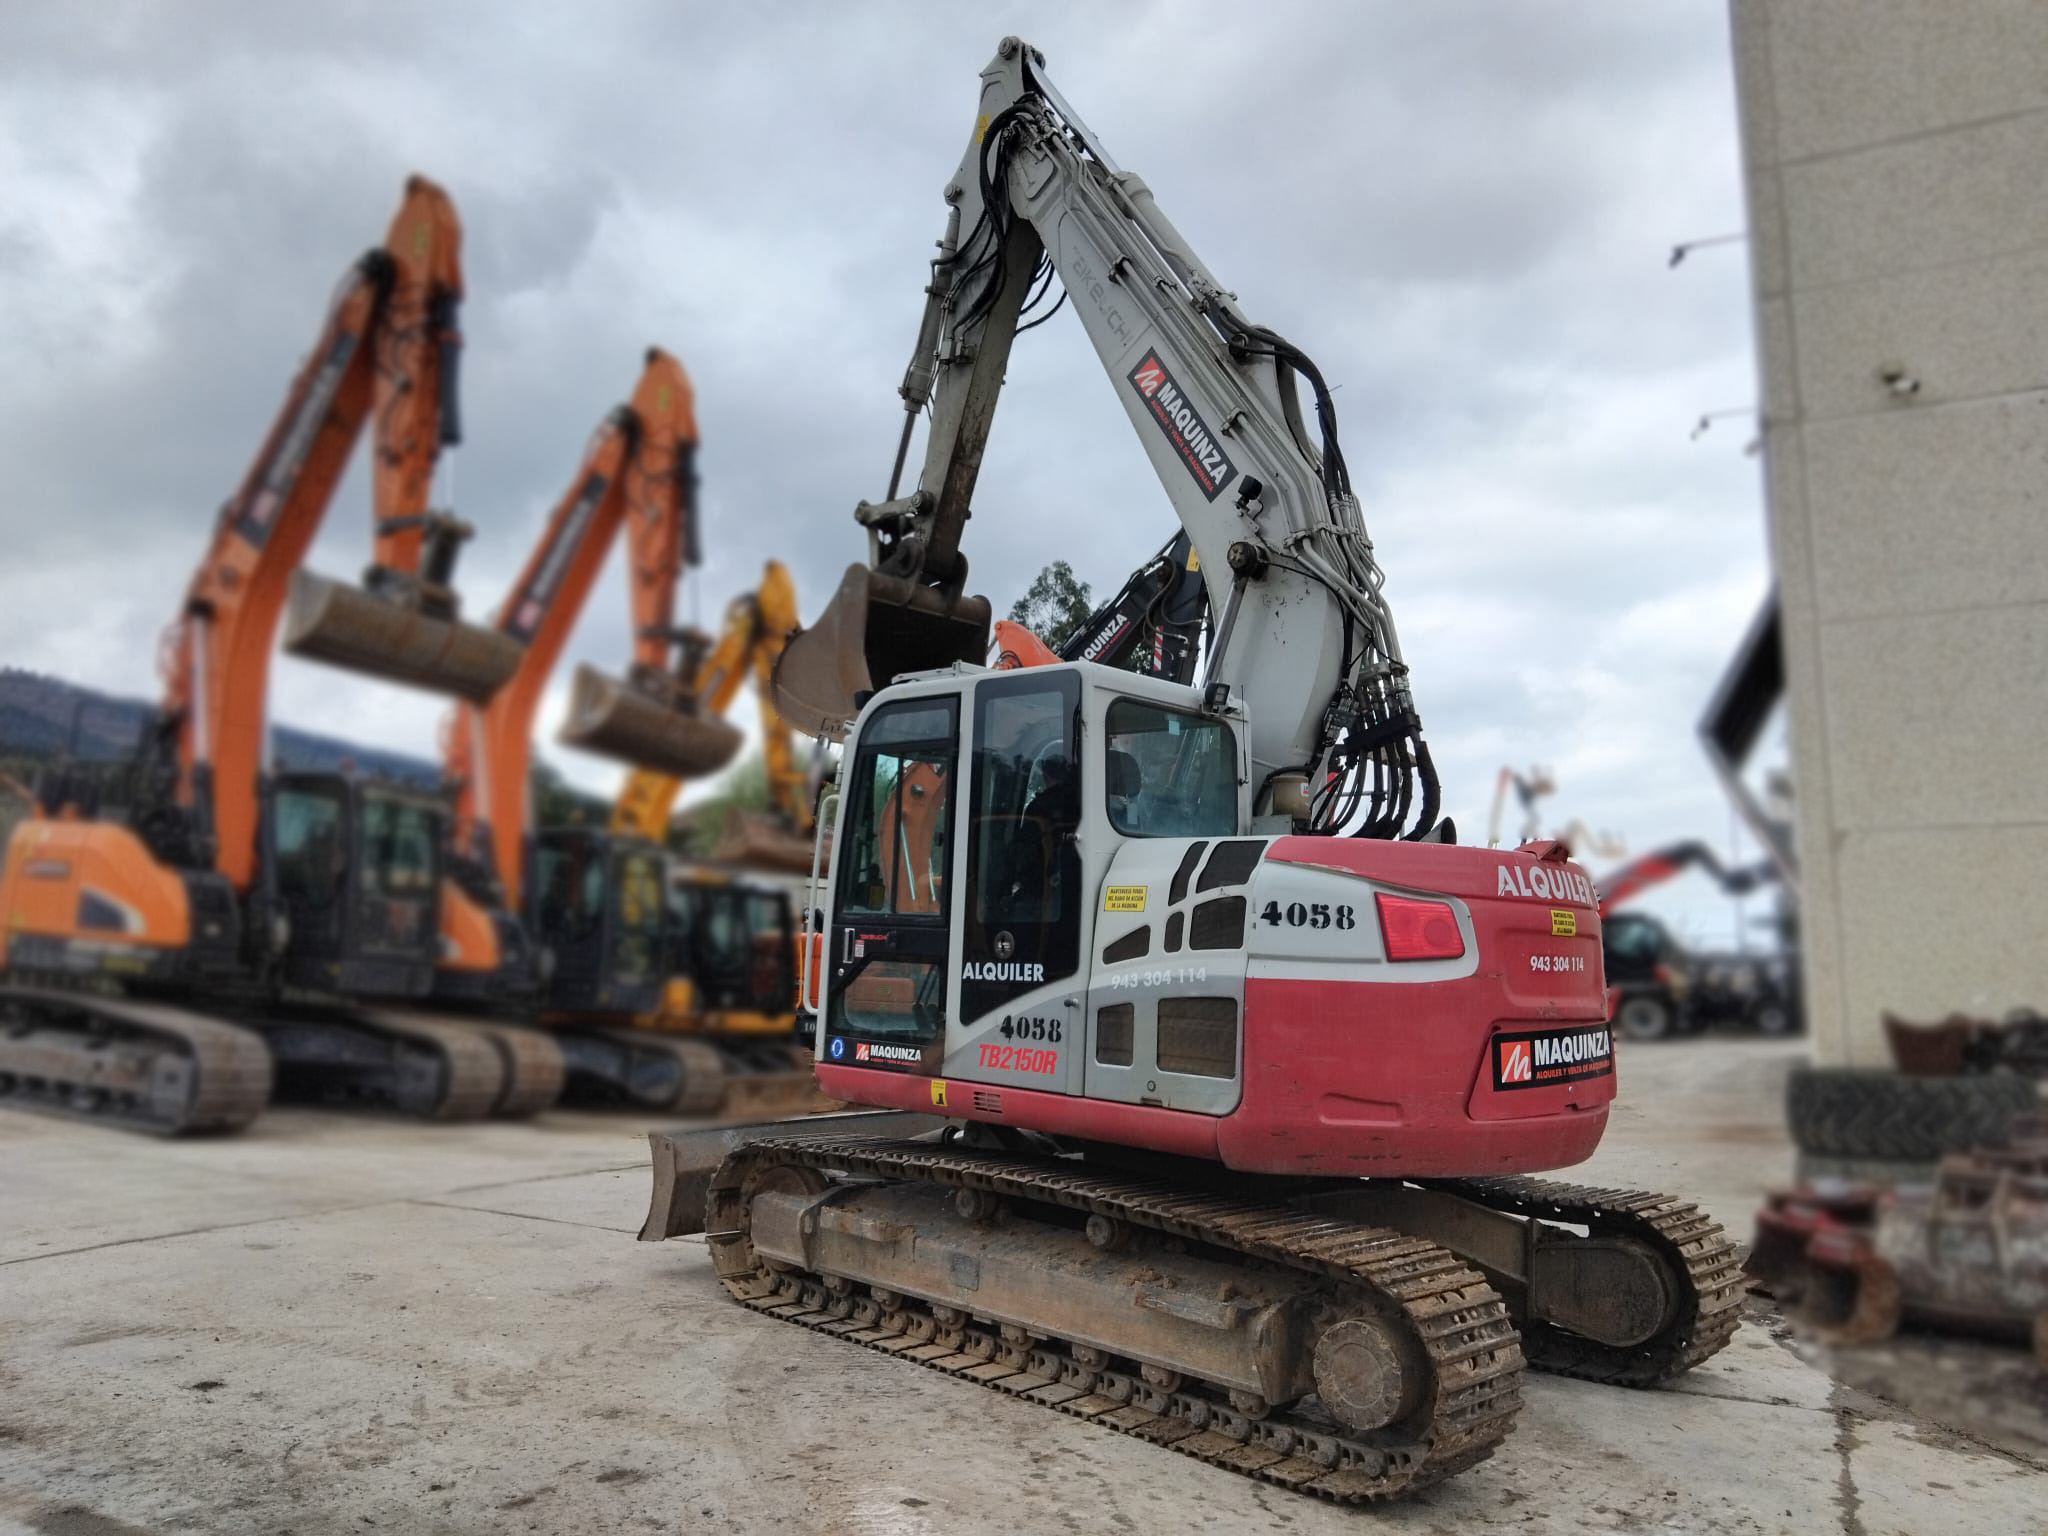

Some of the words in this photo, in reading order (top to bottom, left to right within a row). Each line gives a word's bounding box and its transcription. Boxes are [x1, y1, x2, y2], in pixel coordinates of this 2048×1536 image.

[1157, 382, 1228, 486] MAQUINZA
[1498, 865, 1593, 905] ALQUILER
[1260, 900, 1356, 930] 4058
[962, 961, 1044, 982] ALQUILER
[1111, 974, 1138, 990] 943
[1143, 970, 1171, 987] 304
[1178, 966, 1207, 984] 114
[1530, 955, 1551, 972] 943
[1553, 956, 1569, 972] 304
[1571, 956, 1584, 972] 114
[1000, 1014, 1062, 1043] 4058
[870, 1044, 922, 1062] MAQUINZA
[978, 1043, 1058, 1075] TB2150R
[1534, 1030, 1610, 1067] MAQUINZA
